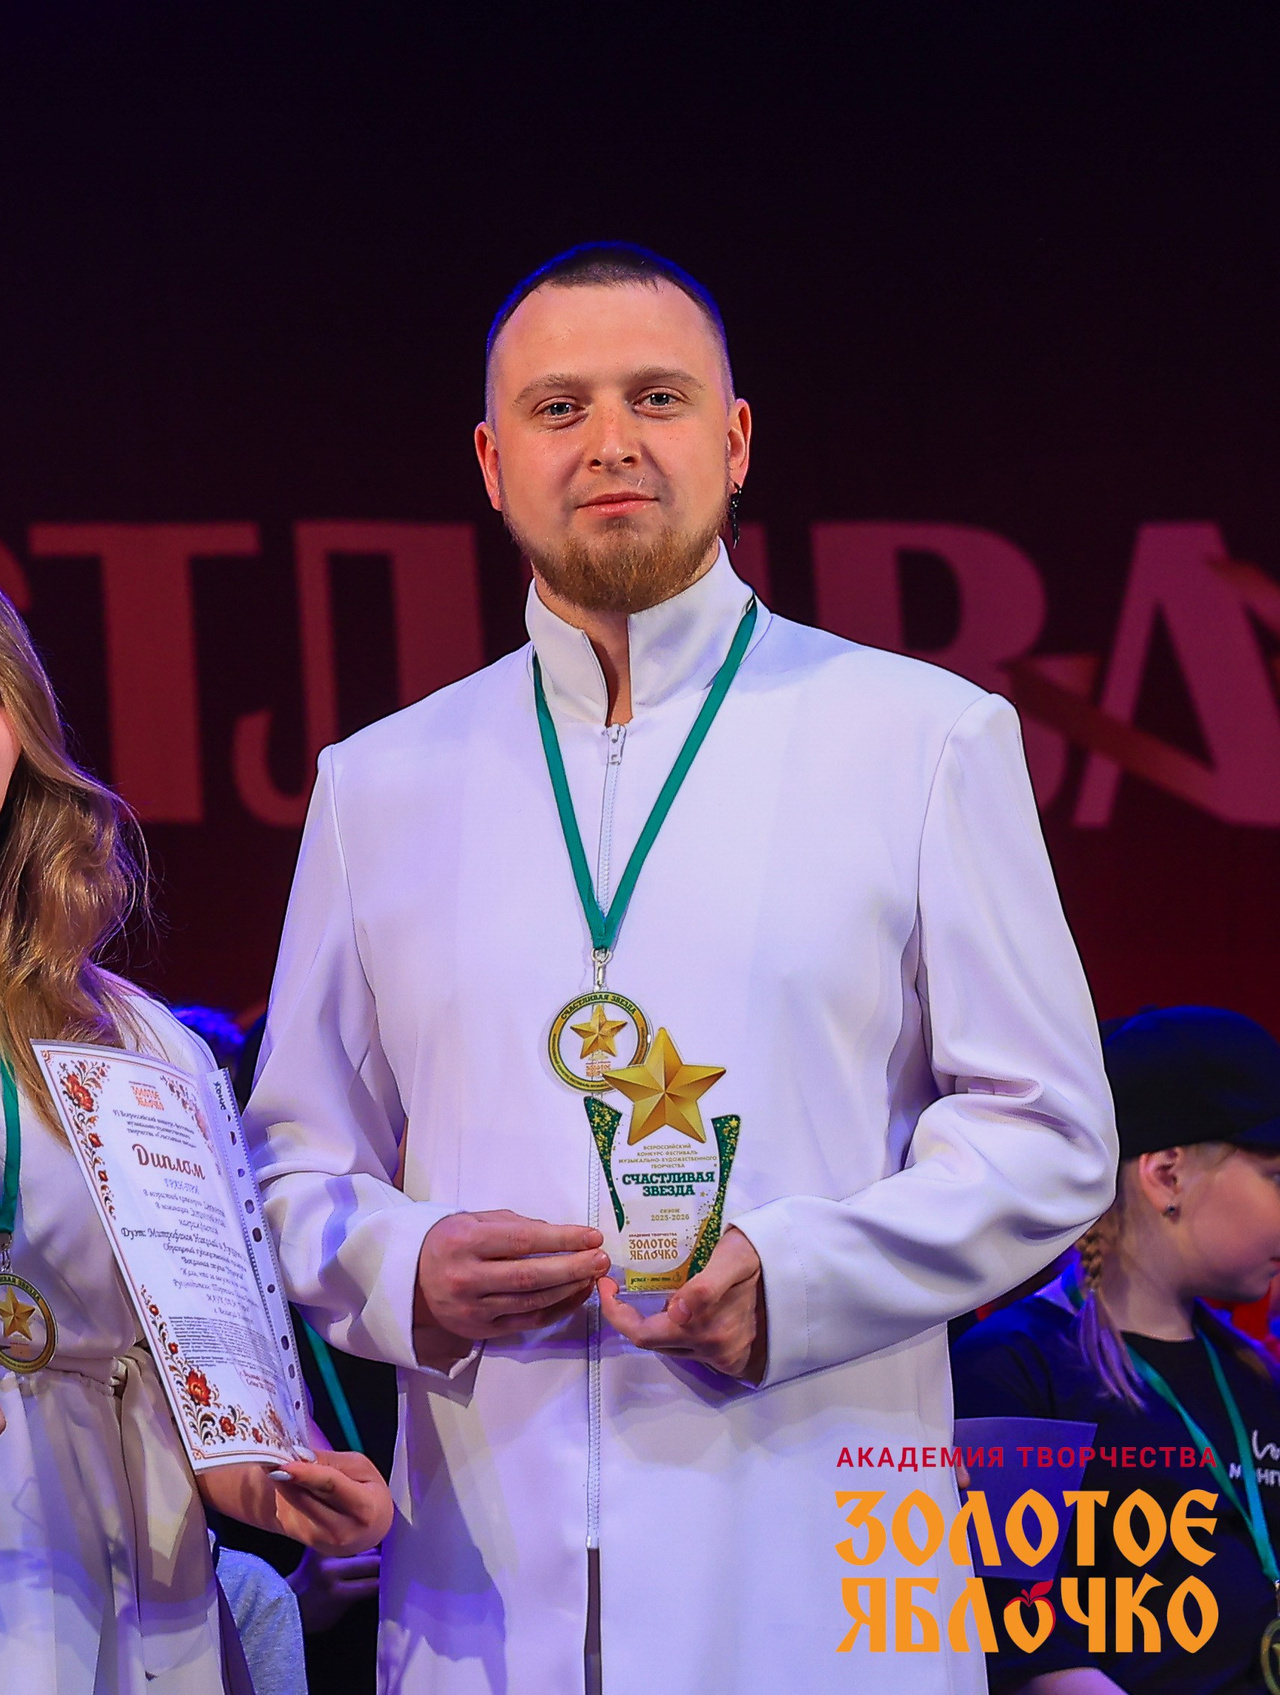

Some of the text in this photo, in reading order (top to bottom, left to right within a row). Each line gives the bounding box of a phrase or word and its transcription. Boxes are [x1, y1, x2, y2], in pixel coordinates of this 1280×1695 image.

[131, 1143, 206, 1180] Диплом
[622, 1170, 716, 1185] СЧАСТЛИВАЯ
[642, 1184, 696, 1197] ЗВЕЗДА
[628, 1238, 678, 1249] ЗОЛОТОЕ
[629, 1249, 679, 1261] ЯБЛОЧКО
